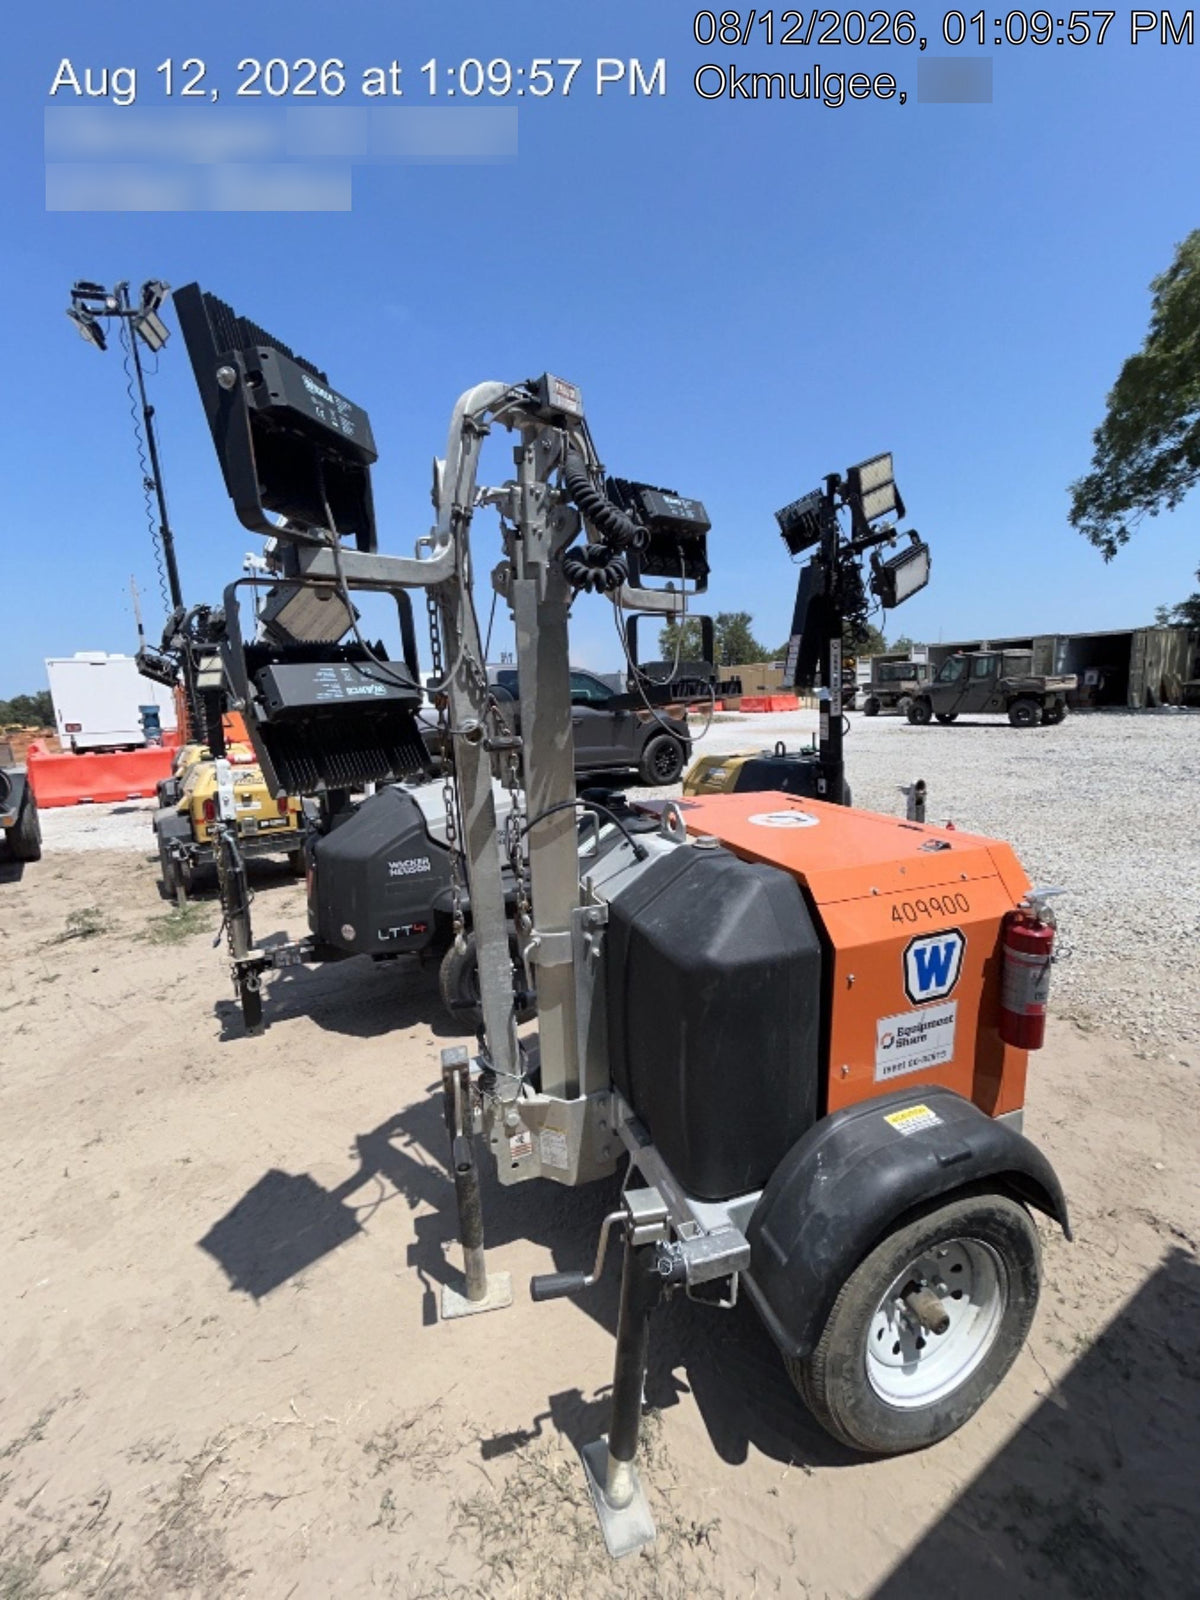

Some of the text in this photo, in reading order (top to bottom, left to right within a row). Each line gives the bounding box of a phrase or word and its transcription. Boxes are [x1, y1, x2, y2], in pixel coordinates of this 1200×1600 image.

[891, 893, 970, 924] 409900
[914, 941, 956, 991] W
[897, 1015, 954, 1037] Equipment
[895, 1034, 928, 1048] Share
